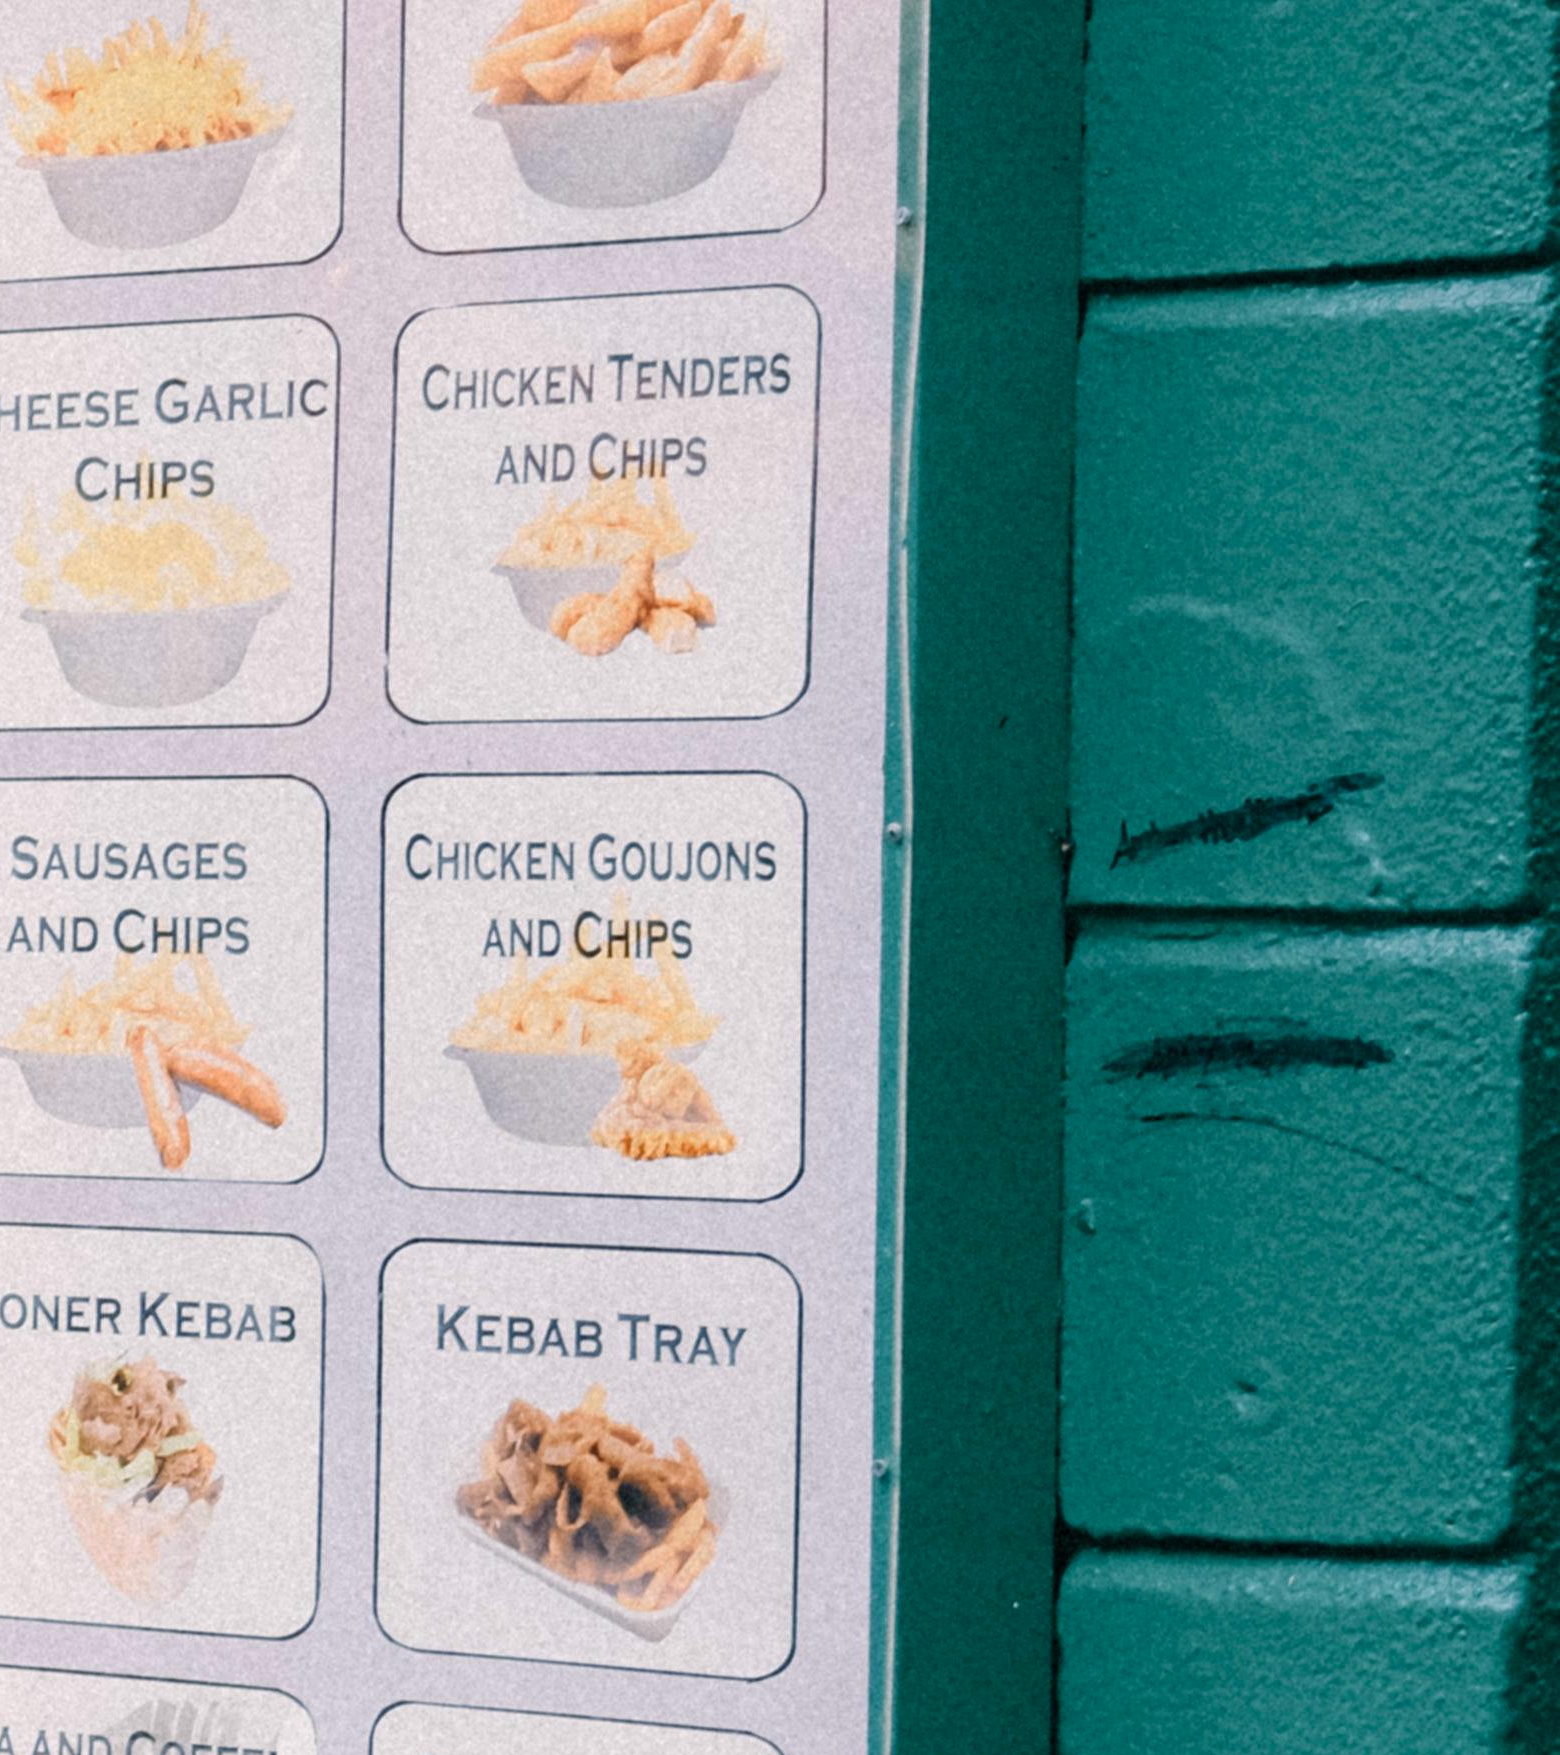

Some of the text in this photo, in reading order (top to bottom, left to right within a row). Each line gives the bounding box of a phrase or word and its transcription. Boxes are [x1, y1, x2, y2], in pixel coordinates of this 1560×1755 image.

[154, 378, 329, 425] GARLIC
[422, 354, 791, 411] CHICKEN TENDERS
[75, 456, 216, 502] CHIPS
[495, 433, 707, 484] AND CHIPS
[10, 835, 247, 880] SAUSAGES
[405, 833, 777, 881] CHICKEN GOUJONS
[7, 909, 250, 954] AND CHIPS
[482, 911, 693, 959] AND CHIPS
[139, 1292, 297, 1343] KEBAB
[436, 1304, 747, 1368] KEBAB TRAY
